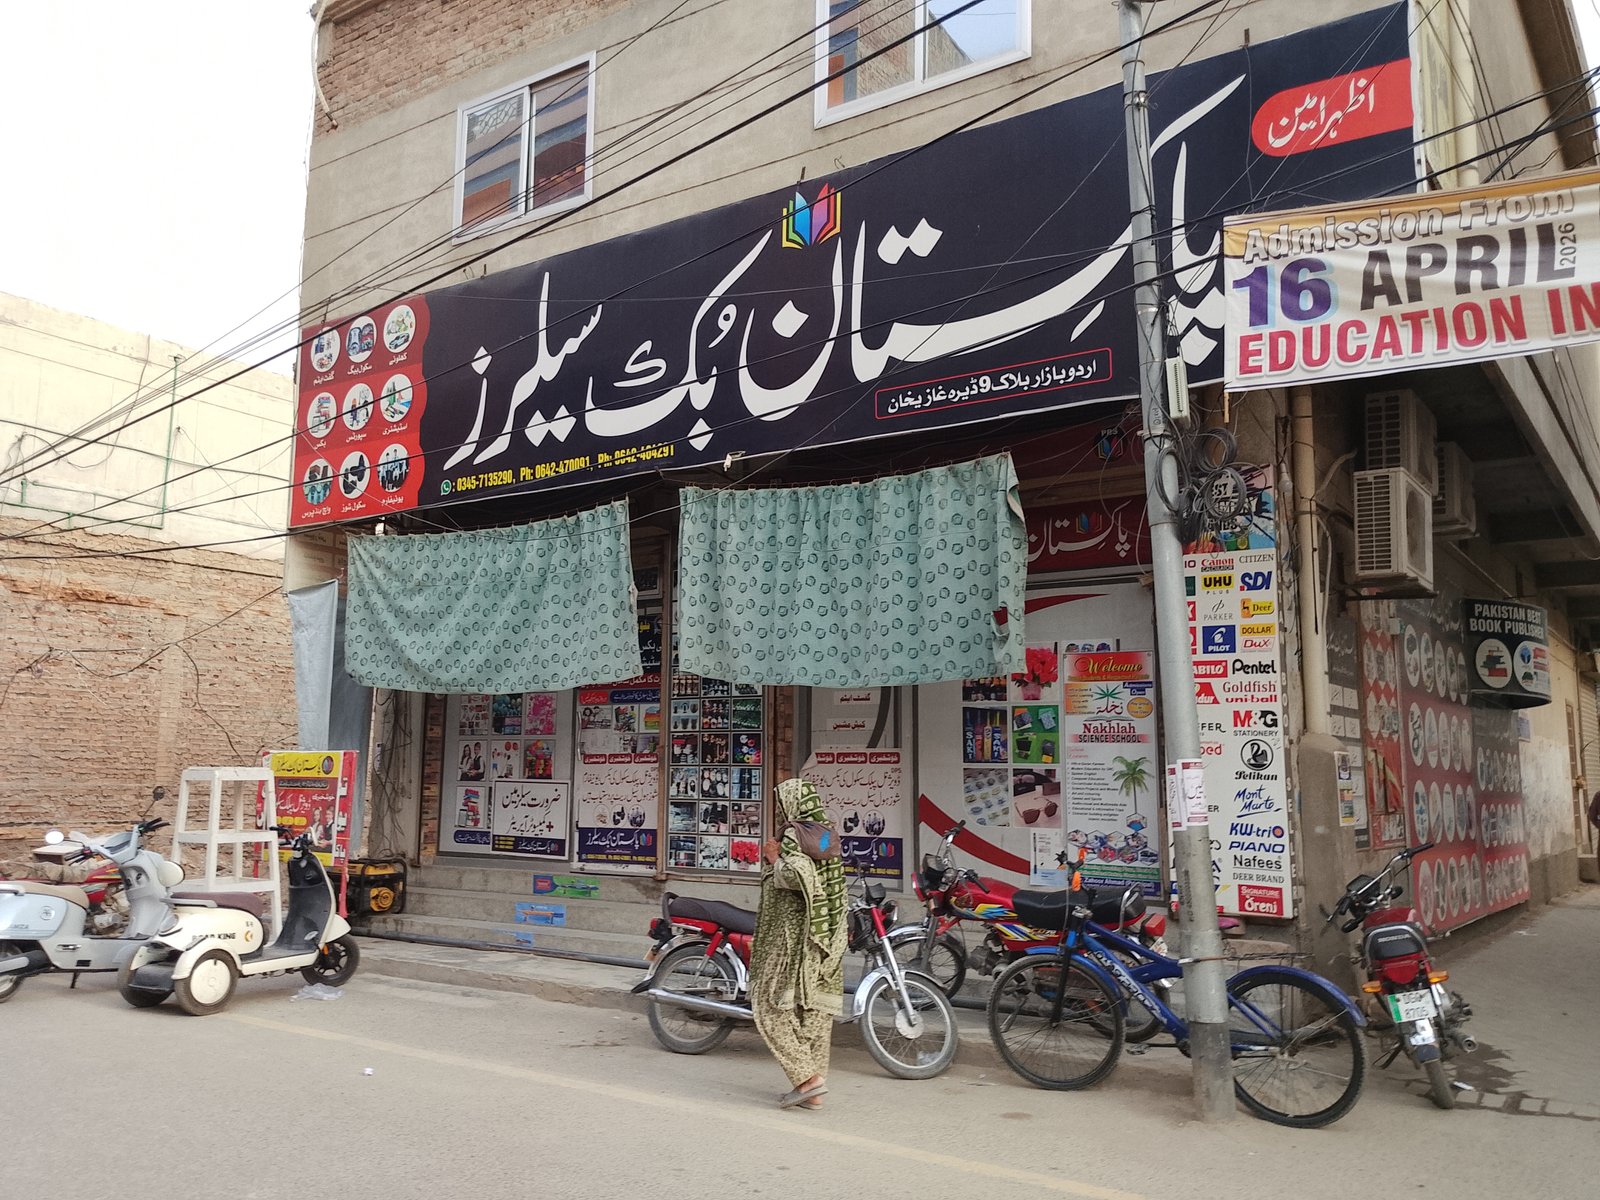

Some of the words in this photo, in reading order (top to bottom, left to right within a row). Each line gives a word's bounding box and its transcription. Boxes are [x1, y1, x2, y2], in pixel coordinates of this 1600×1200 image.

[1243, 209, 1443, 265] Admission
[1458, 188, 1576, 232] From
[1232, 257, 1334, 328] 16
[1360, 222, 1576, 311] APRIL
[1559, 222, 1579, 268] 2026
[1238, 295, 1528, 376] EDUCATION
[1201, 559, 1234, 567] Canon
[1239, 554, 1275, 564] CITIZEN
[1203, 575, 1232, 588] UHU
[1240, 571, 1273, 592] SDI
[1252, 603, 1272, 612] Deer
[1474, 603, 1526, 621] PAKISTAN
[1242, 626, 1272, 635] DOLLAR
[1469, 618, 1502, 633] BOOK
[1075, 656, 1143, 673] Welcome
[1232, 658, 1277, 675] Pentel
[1222, 680, 1277, 693] Goldfish
[1225, 694, 1278, 703] uni-ball
[1083, 721, 1136, 734] Nakhlah
[1078, 734, 1109, 743] SCIENCE
[1110, 734, 1142, 743] SCHOOL
[1235, 770, 1278, 781] Pelikan
[1234, 784, 1266, 802] Mont
[1229, 841, 1286, 853] PIANO
[1233, 854, 1282, 870] Nafees
[1232, 872, 1255, 881] DEER
[1255, 874, 1285, 884] BRAND
